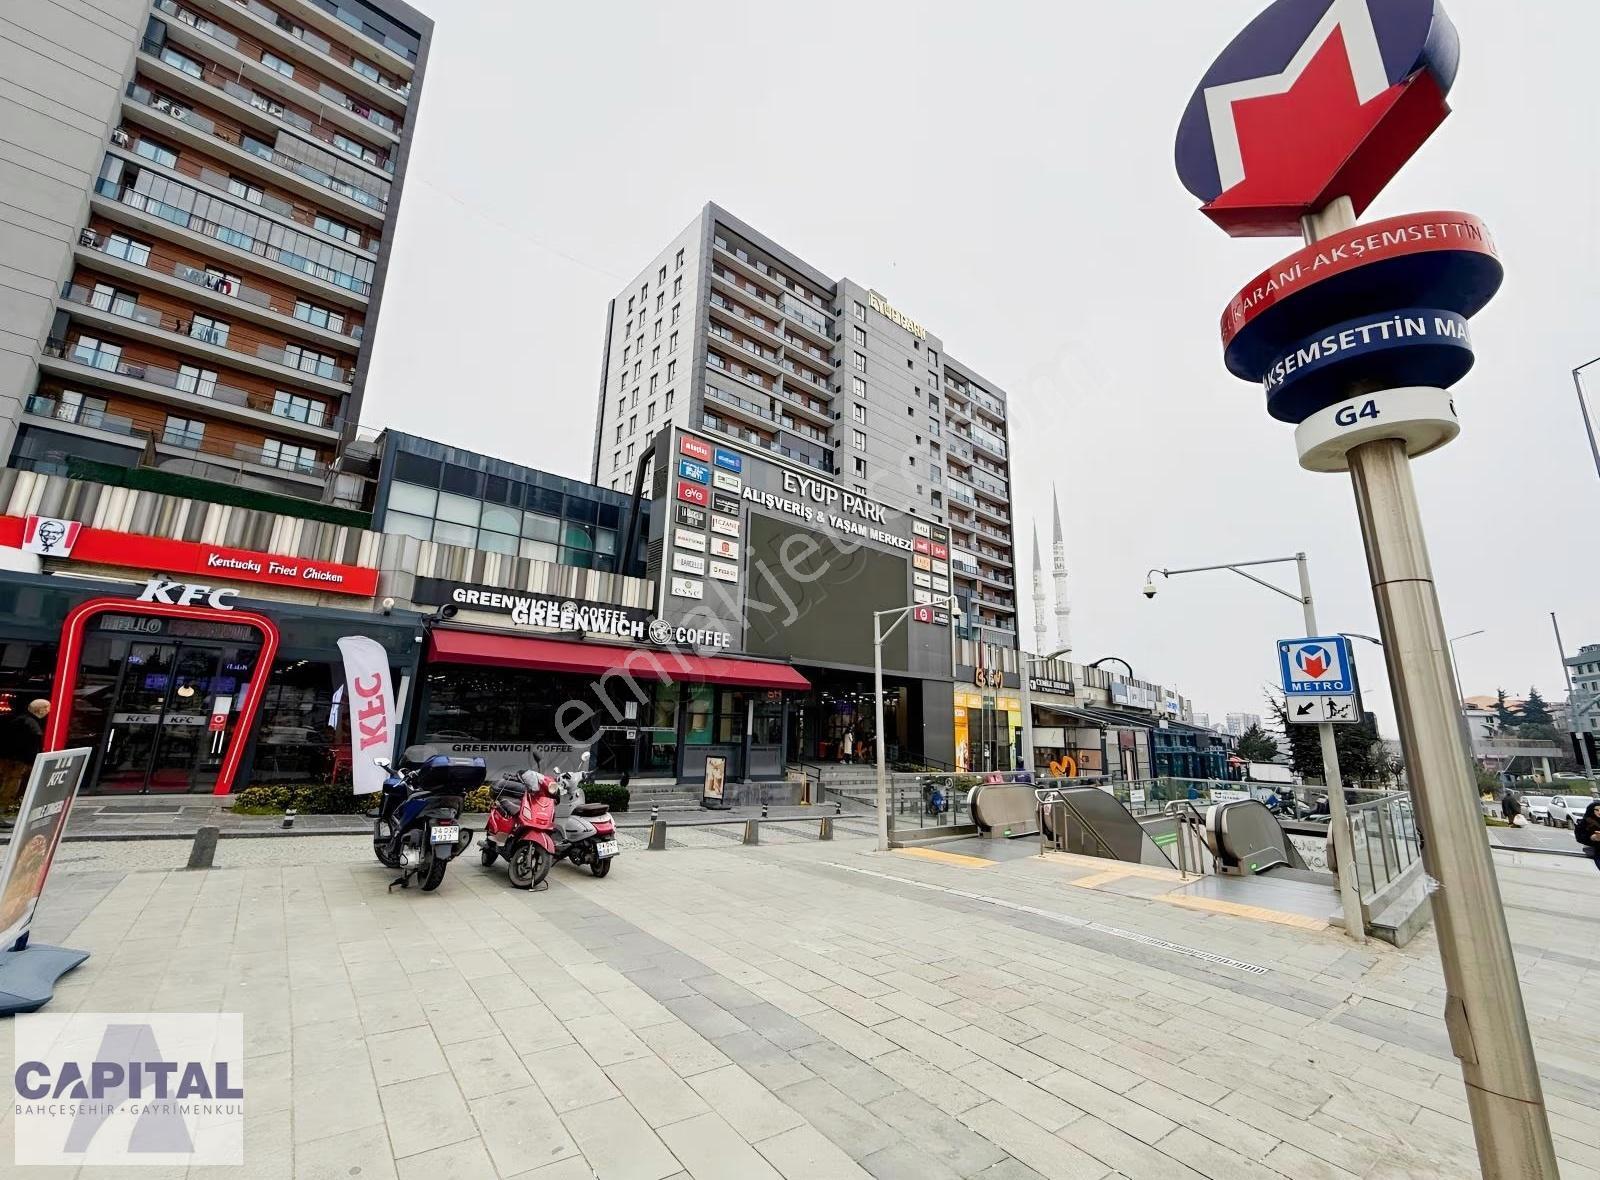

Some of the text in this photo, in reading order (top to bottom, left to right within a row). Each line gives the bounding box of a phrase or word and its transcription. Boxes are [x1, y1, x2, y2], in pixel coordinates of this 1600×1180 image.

[1334, 399, 1380, 428] G4
[742, 486, 814, 522] ALIŞVERİŞ
[816, 510, 826, 525] &
[828, 513, 867, 538] YAŞAM
[782, 469, 887, 526] EYÜP PARK
[207, 553, 343, 582] Kentucky Fried Chicken
[137, 579, 240, 610] KFC
[452, 588, 627, 621] GREENWICH COFFEE
[511, 606, 731, 648] GREENWICH COFFEE
[1292, 681, 1344, 691] METRO
[126, 714, 153, 723] KFC
[170, 716, 195, 724] KFC
[354, 672, 388, 751] KFC
[452, 744, 573, 753] GREENWICH COFFEE
[46, 770, 69, 787] KFC
